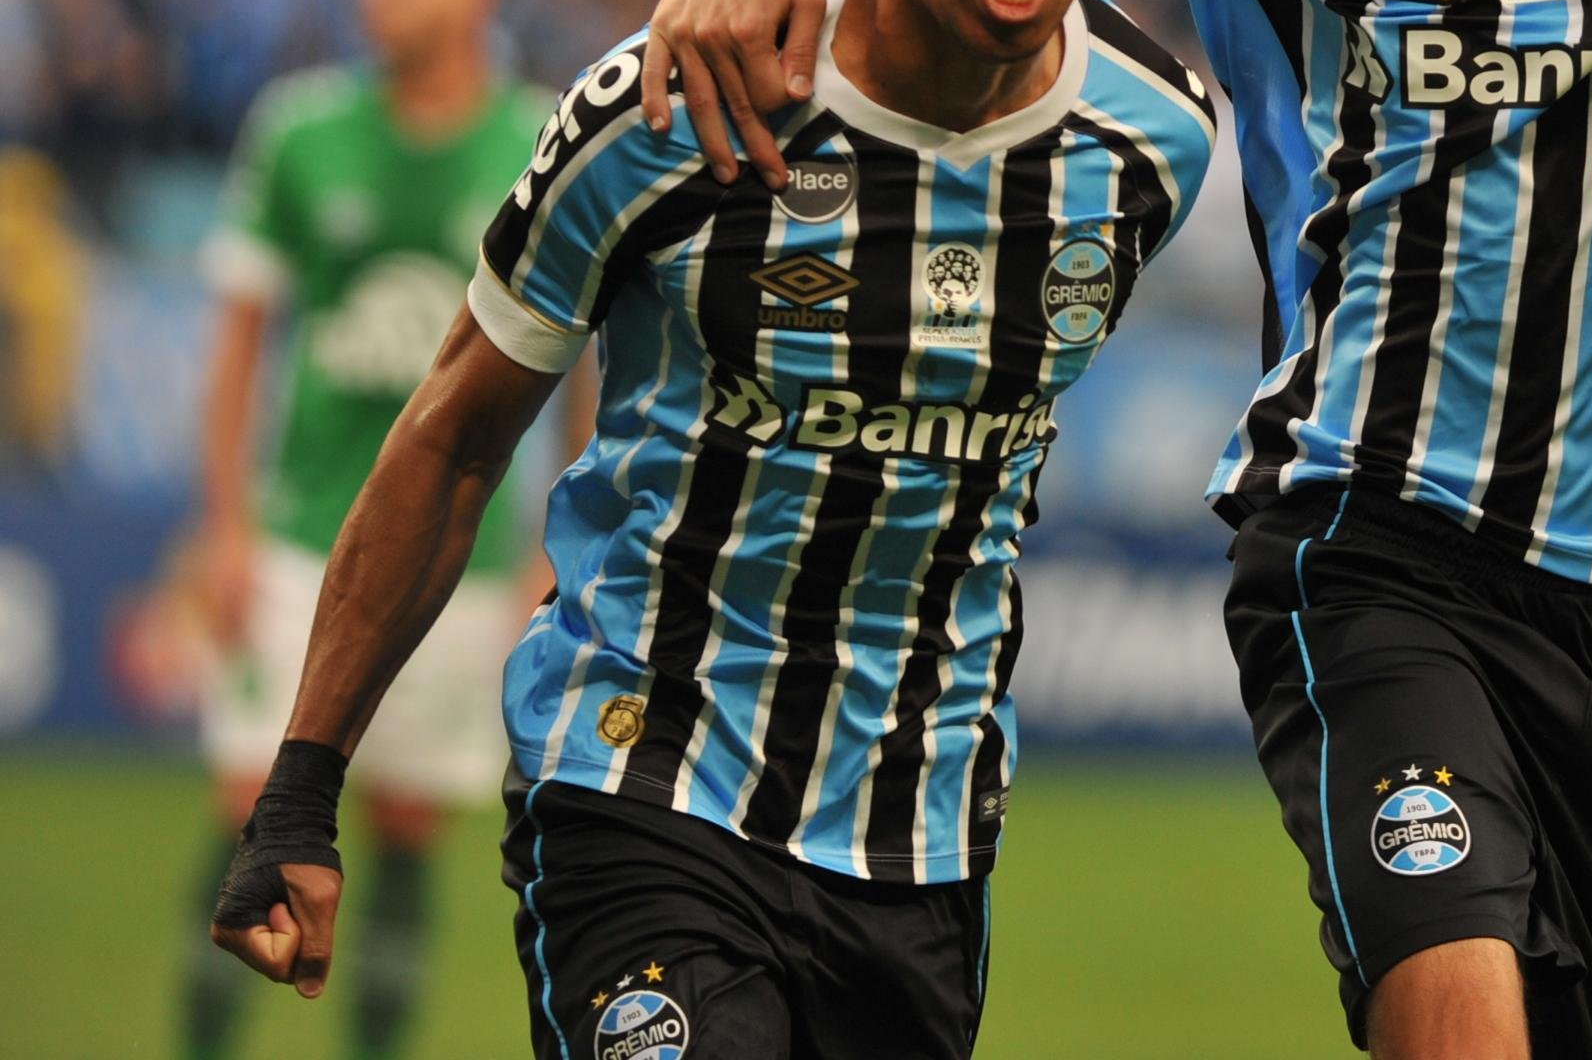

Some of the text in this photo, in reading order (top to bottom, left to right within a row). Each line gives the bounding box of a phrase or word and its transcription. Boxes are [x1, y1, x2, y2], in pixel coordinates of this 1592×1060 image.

[1072, 260, 1090, 270] 1903
[1046, 280, 1111, 305] GRÊMIO
[757, 307, 846, 329] umbro
[1406, 803, 1428, 813] 1903
[1378, 819, 1465, 851] GRÊMIO
[622, 1010, 642, 1024] 1903
[602, 1019, 681, 1060] GRÊMIO
